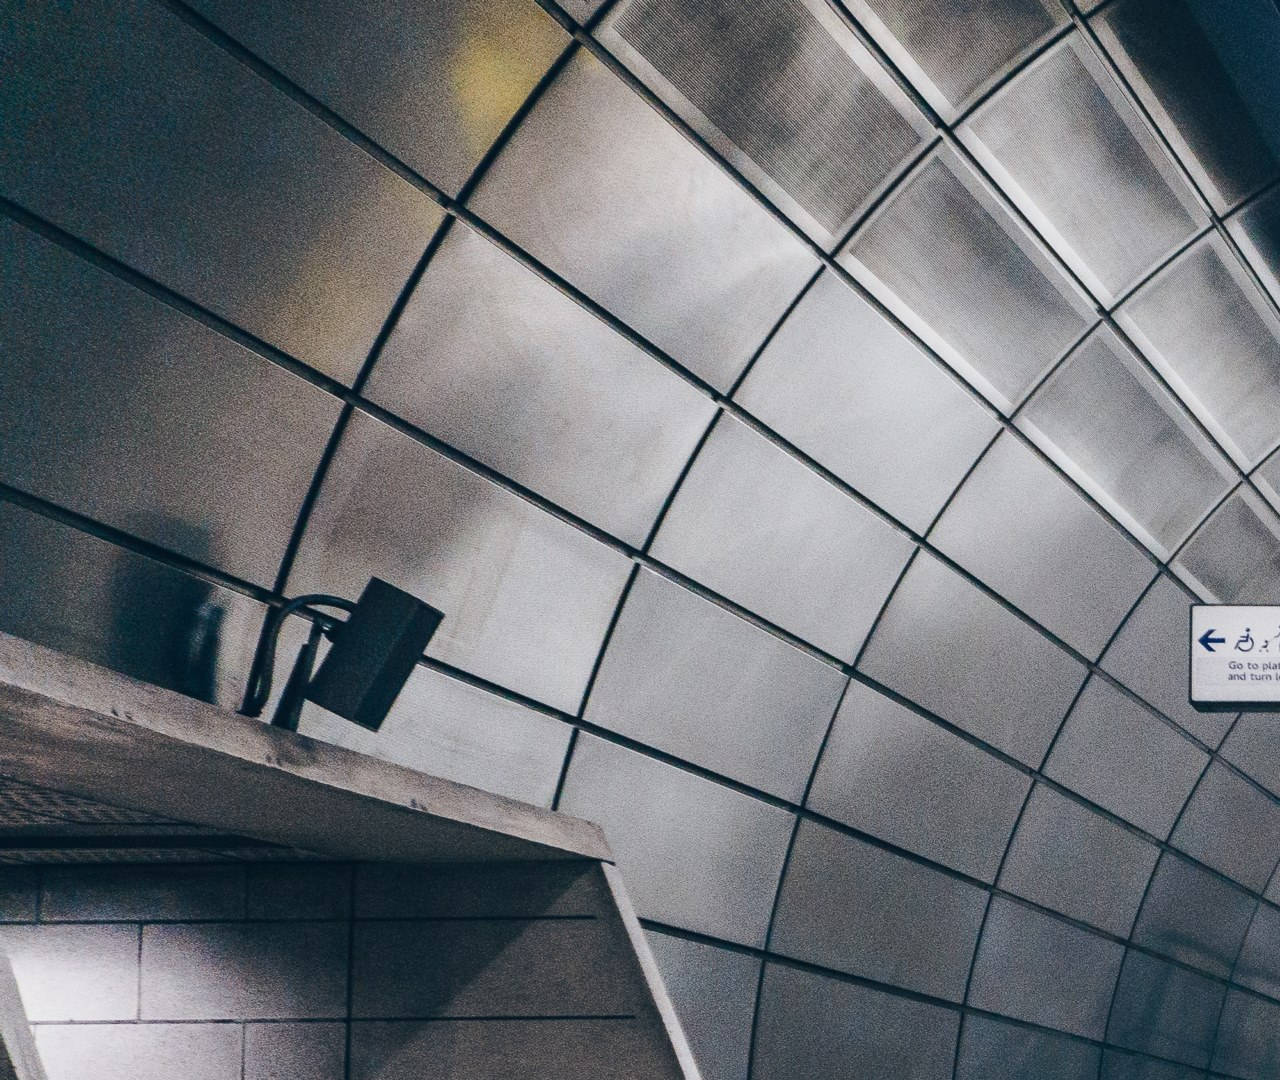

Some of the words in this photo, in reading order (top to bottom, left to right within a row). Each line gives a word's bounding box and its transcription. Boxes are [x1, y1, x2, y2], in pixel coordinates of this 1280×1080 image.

[1228, 661, 1243, 670] Go
[1247, 662, 1259, 670] to
[1228, 673, 1246, 681] and
[1250, 673, 1272, 681] turn
